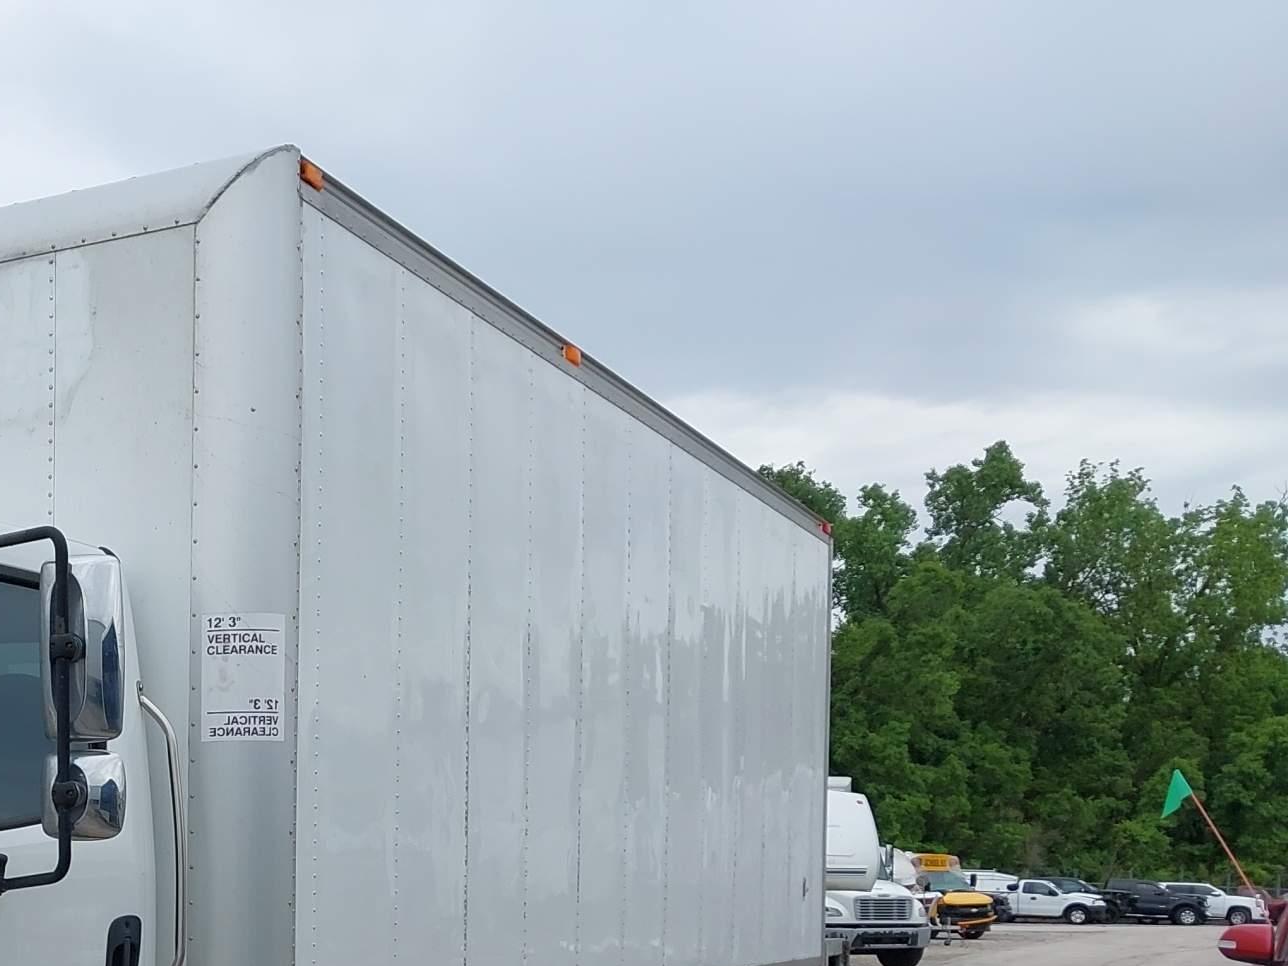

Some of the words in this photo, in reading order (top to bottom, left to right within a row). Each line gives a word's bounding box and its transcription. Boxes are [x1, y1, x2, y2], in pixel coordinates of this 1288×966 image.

[207, 617, 224, 628] 12'
[228, 616, 241, 628] 3"
[207, 633, 265, 643] VERTICAL
[207, 645, 278, 655] CLEARANCE
